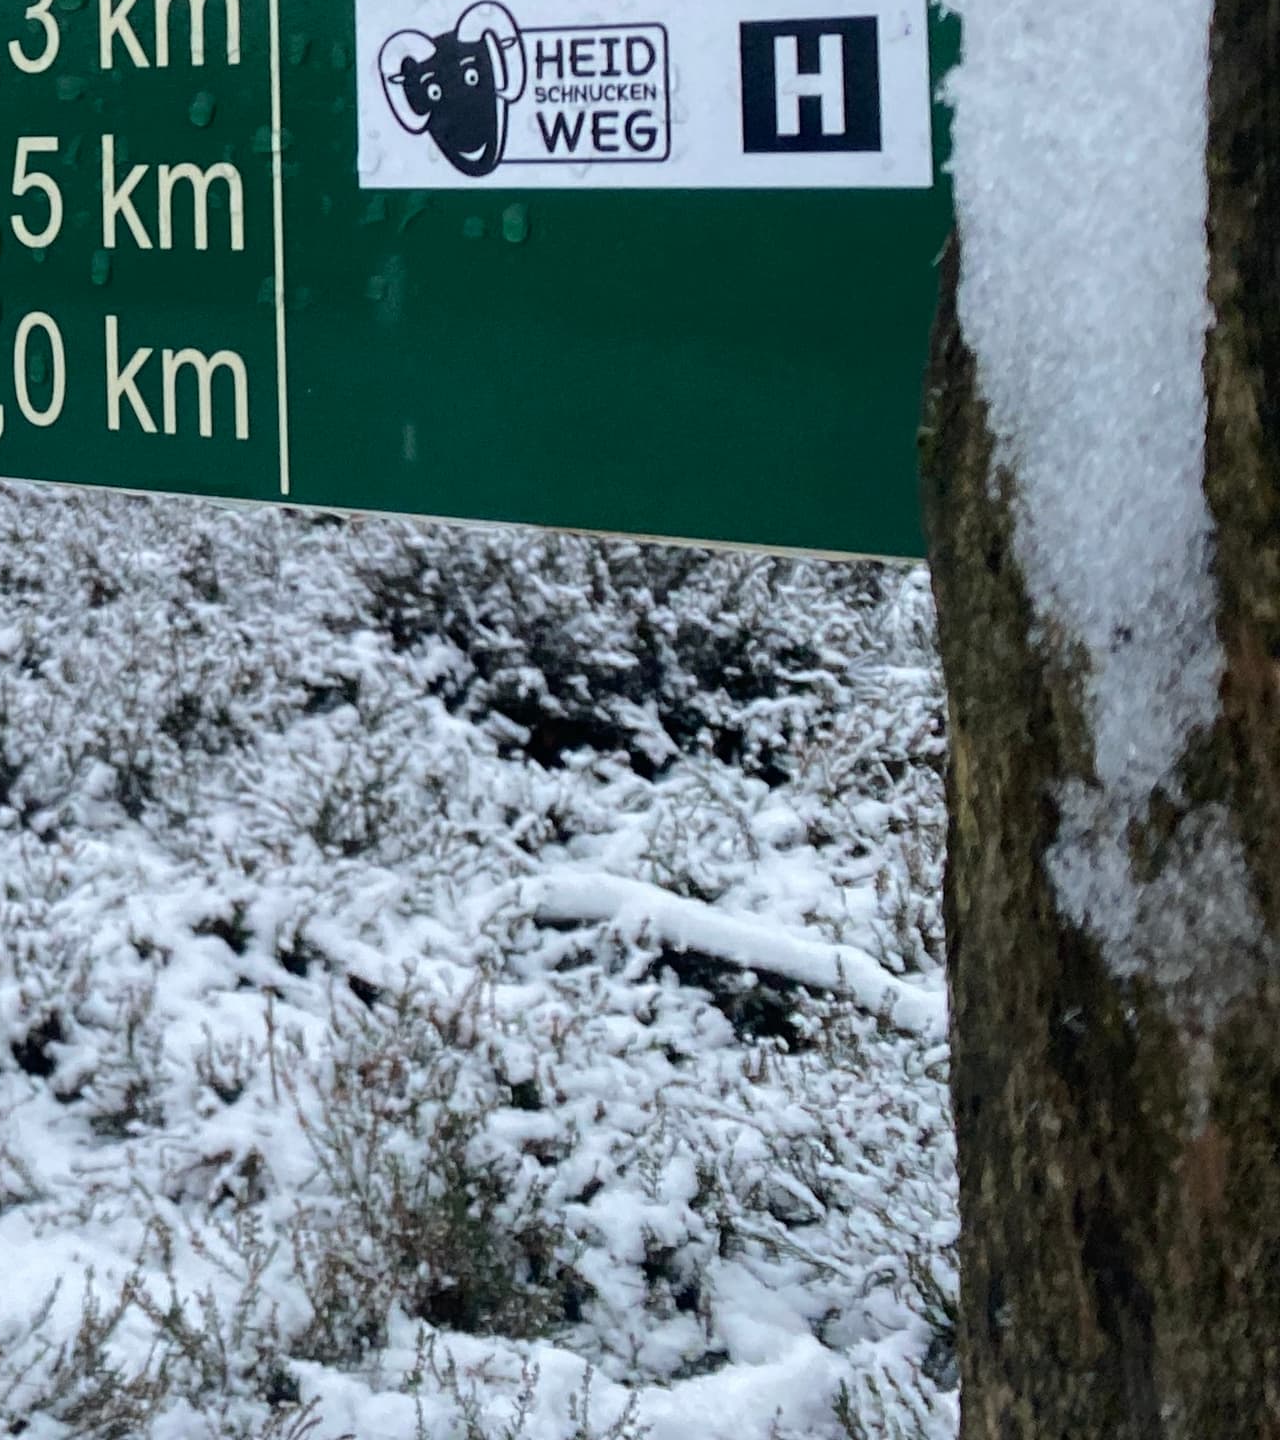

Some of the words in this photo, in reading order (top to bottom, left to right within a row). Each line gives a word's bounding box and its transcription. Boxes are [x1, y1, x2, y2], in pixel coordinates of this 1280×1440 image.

[534, 84, 657, 103] SCHNUCKEN
[535, 35, 657, 80] HEID
[774, 33, 845, 137] H
[536, 110, 658, 153] WEG
[102, 134, 245, 251] km
[105, 315, 249, 440] km
